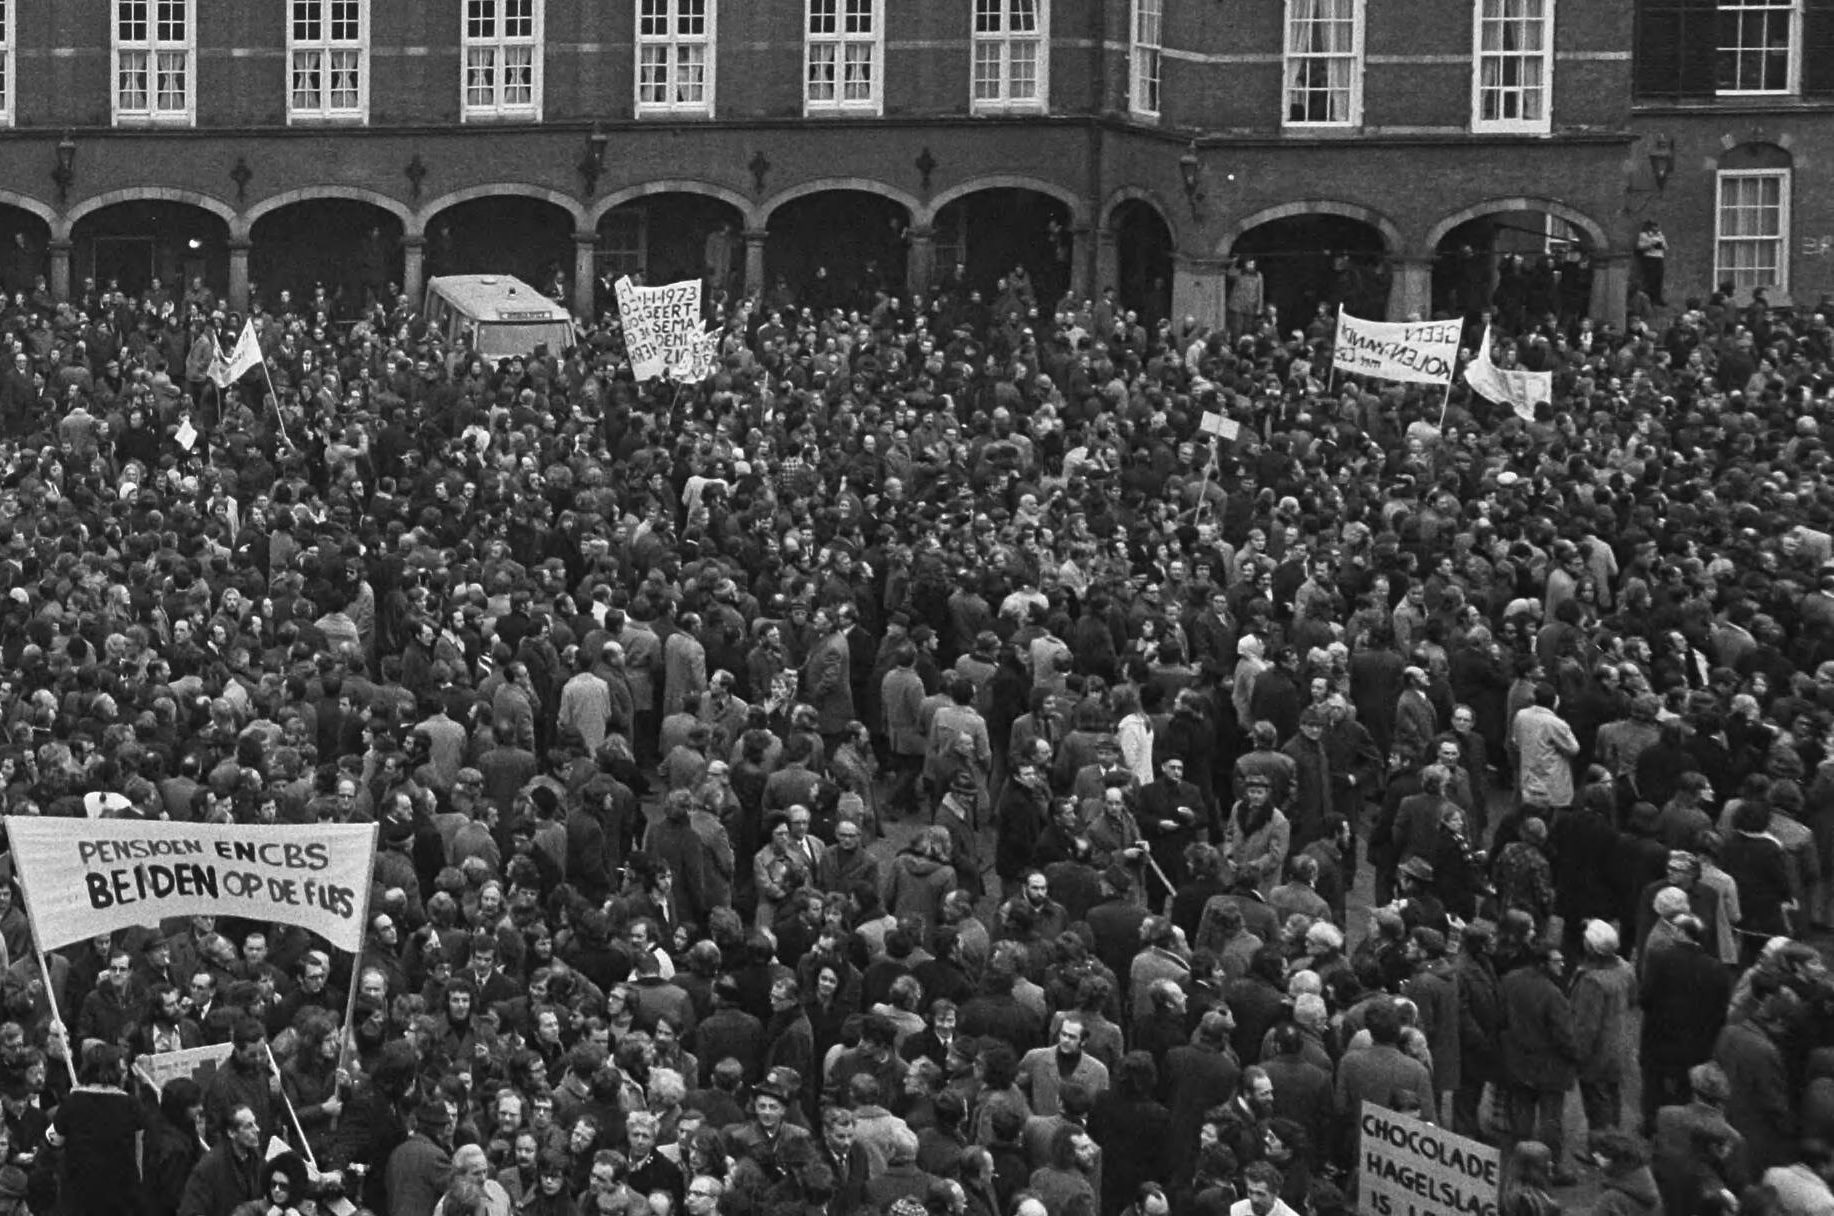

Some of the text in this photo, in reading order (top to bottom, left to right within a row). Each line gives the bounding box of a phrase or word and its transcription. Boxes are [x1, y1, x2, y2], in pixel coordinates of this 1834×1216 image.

[79, 839, 329, 870] PENSIOEN EN CBS
[85, 863, 219, 909] BEIDEN
[223, 870, 263, 898] OP
[269, 878, 300, 905] DE
[1363, 1115, 1497, 1185] CHOCOLADE
[1372, 1191, 1391, 1215] IS
